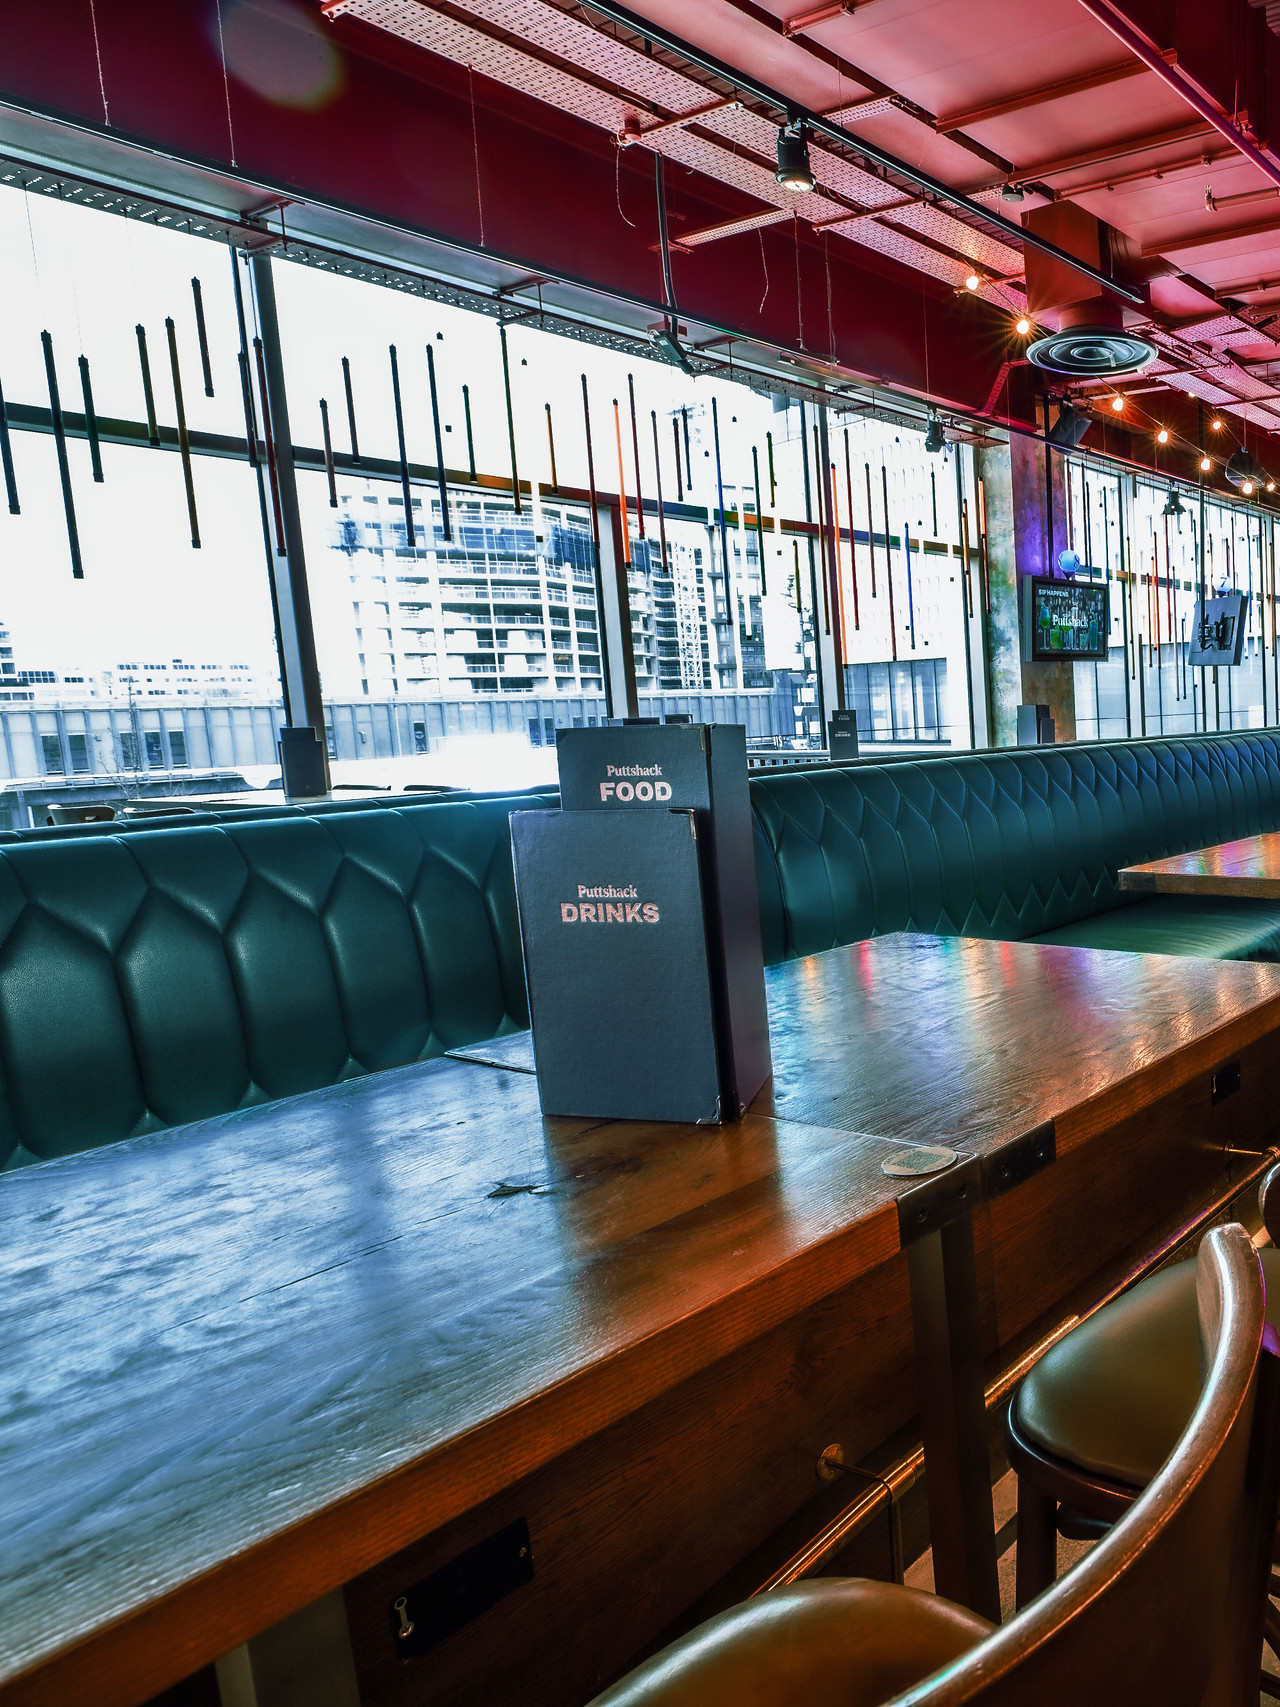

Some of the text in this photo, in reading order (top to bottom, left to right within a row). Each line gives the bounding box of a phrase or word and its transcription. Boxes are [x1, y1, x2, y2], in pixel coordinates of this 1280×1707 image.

[1047, 589, 1069, 598] HAPPENS
[1052, 614, 1089, 628] Puttshack
[606, 763, 663, 777] Puttshack
[599, 781, 673, 802] FOOD
[576, 884, 638, 899] Puttshack
[560, 902, 660, 923] DRINKS
